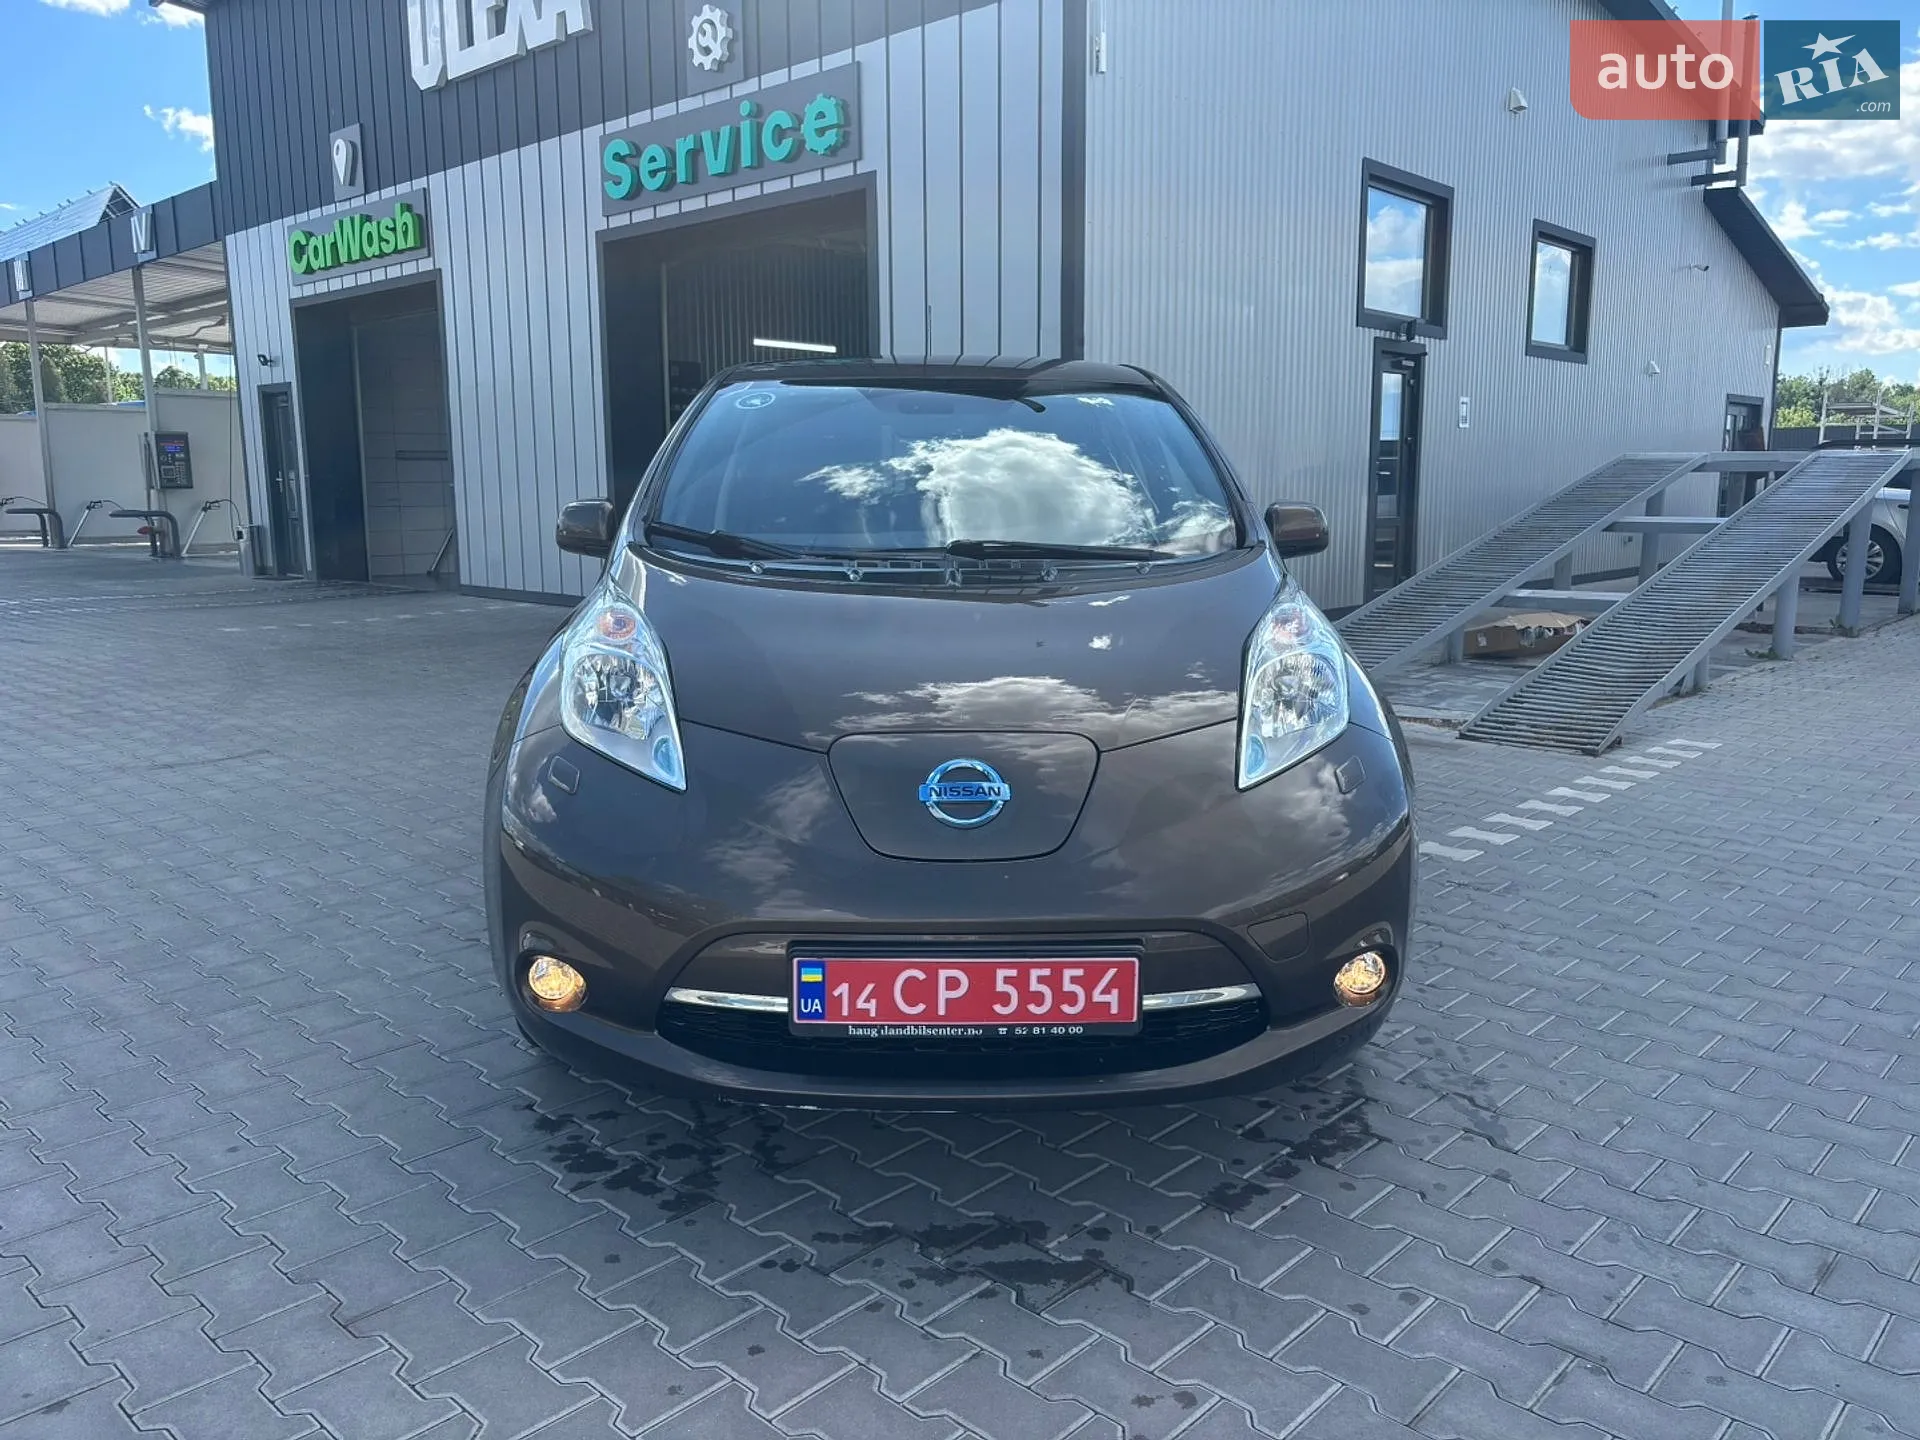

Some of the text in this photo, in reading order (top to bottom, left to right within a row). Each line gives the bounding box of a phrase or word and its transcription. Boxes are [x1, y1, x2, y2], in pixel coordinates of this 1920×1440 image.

[603, 93, 844, 200] Service
[288, 202, 420, 275] CarWash
[929, 786, 1001, 798] NISSAN
[800, 998, 823, 1013] UA
[831, 967, 1119, 1017] 14 CP 5554
[1033, 1026, 1047, 1035] 81
[1050, 1026, 1066, 1035] 40
[1068, 1025, 1084, 1035] 00
